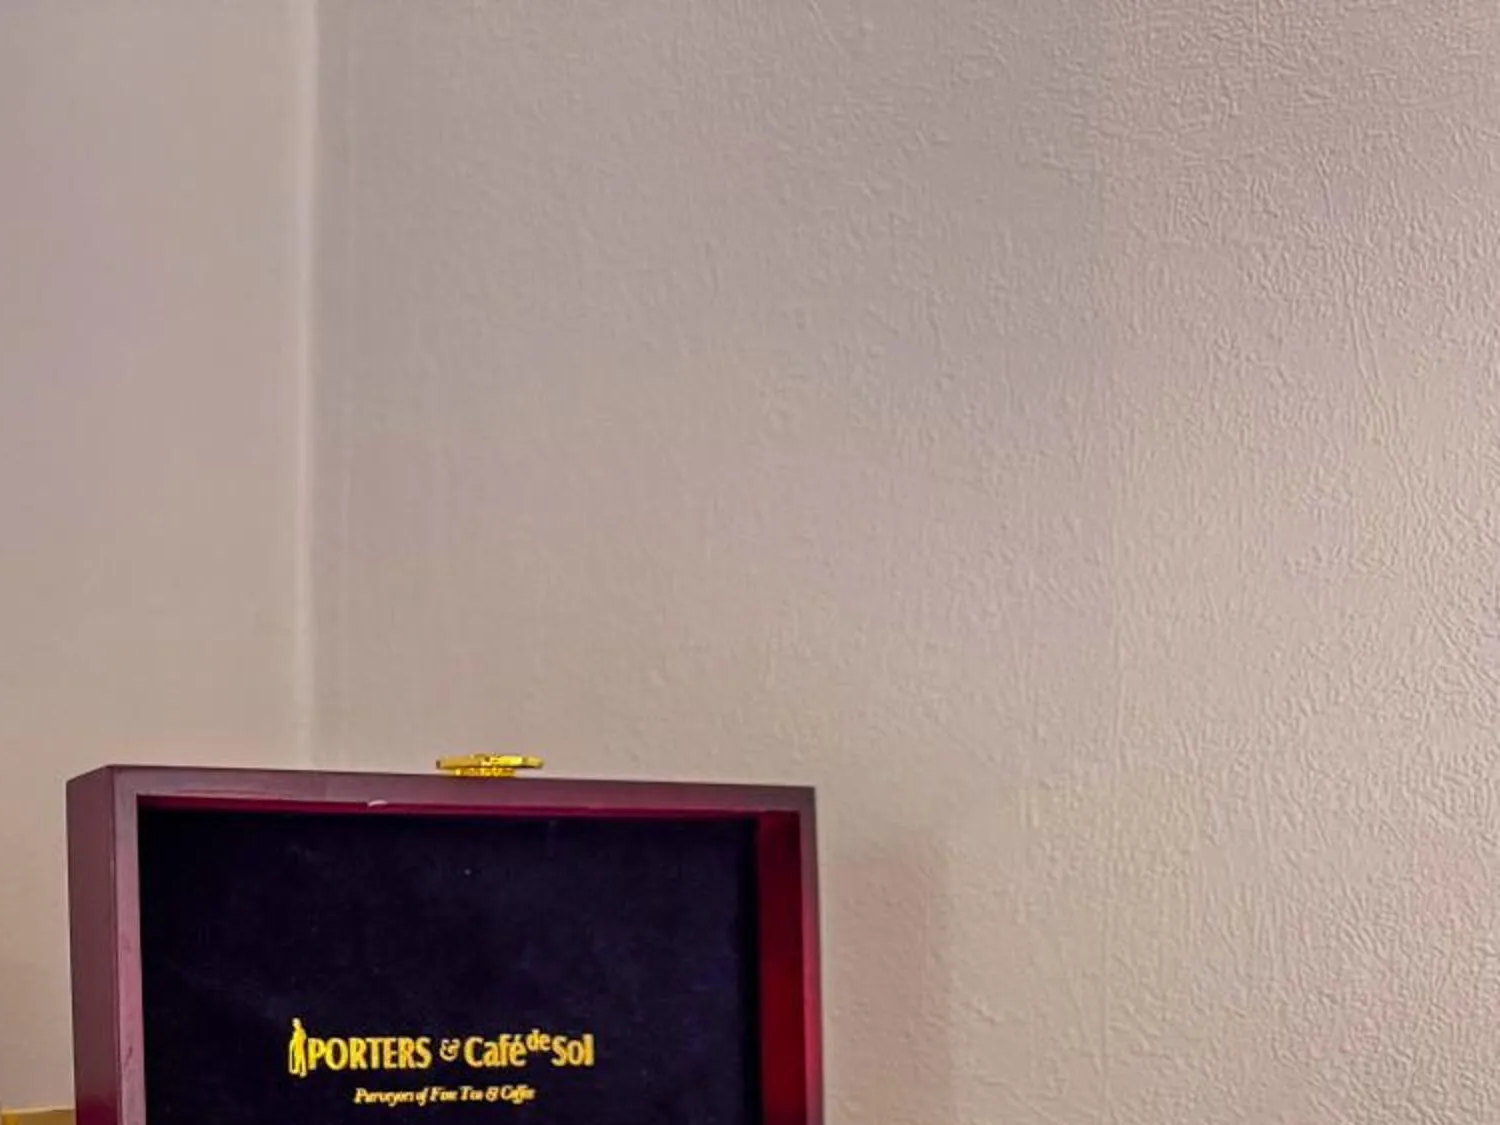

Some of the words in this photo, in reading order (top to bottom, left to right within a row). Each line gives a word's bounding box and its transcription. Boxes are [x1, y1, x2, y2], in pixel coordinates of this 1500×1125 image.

[307, 1036, 432, 1071] PORTERS
[440, 1038, 460, 1062] &
[550, 1033, 595, 1067] Sol
